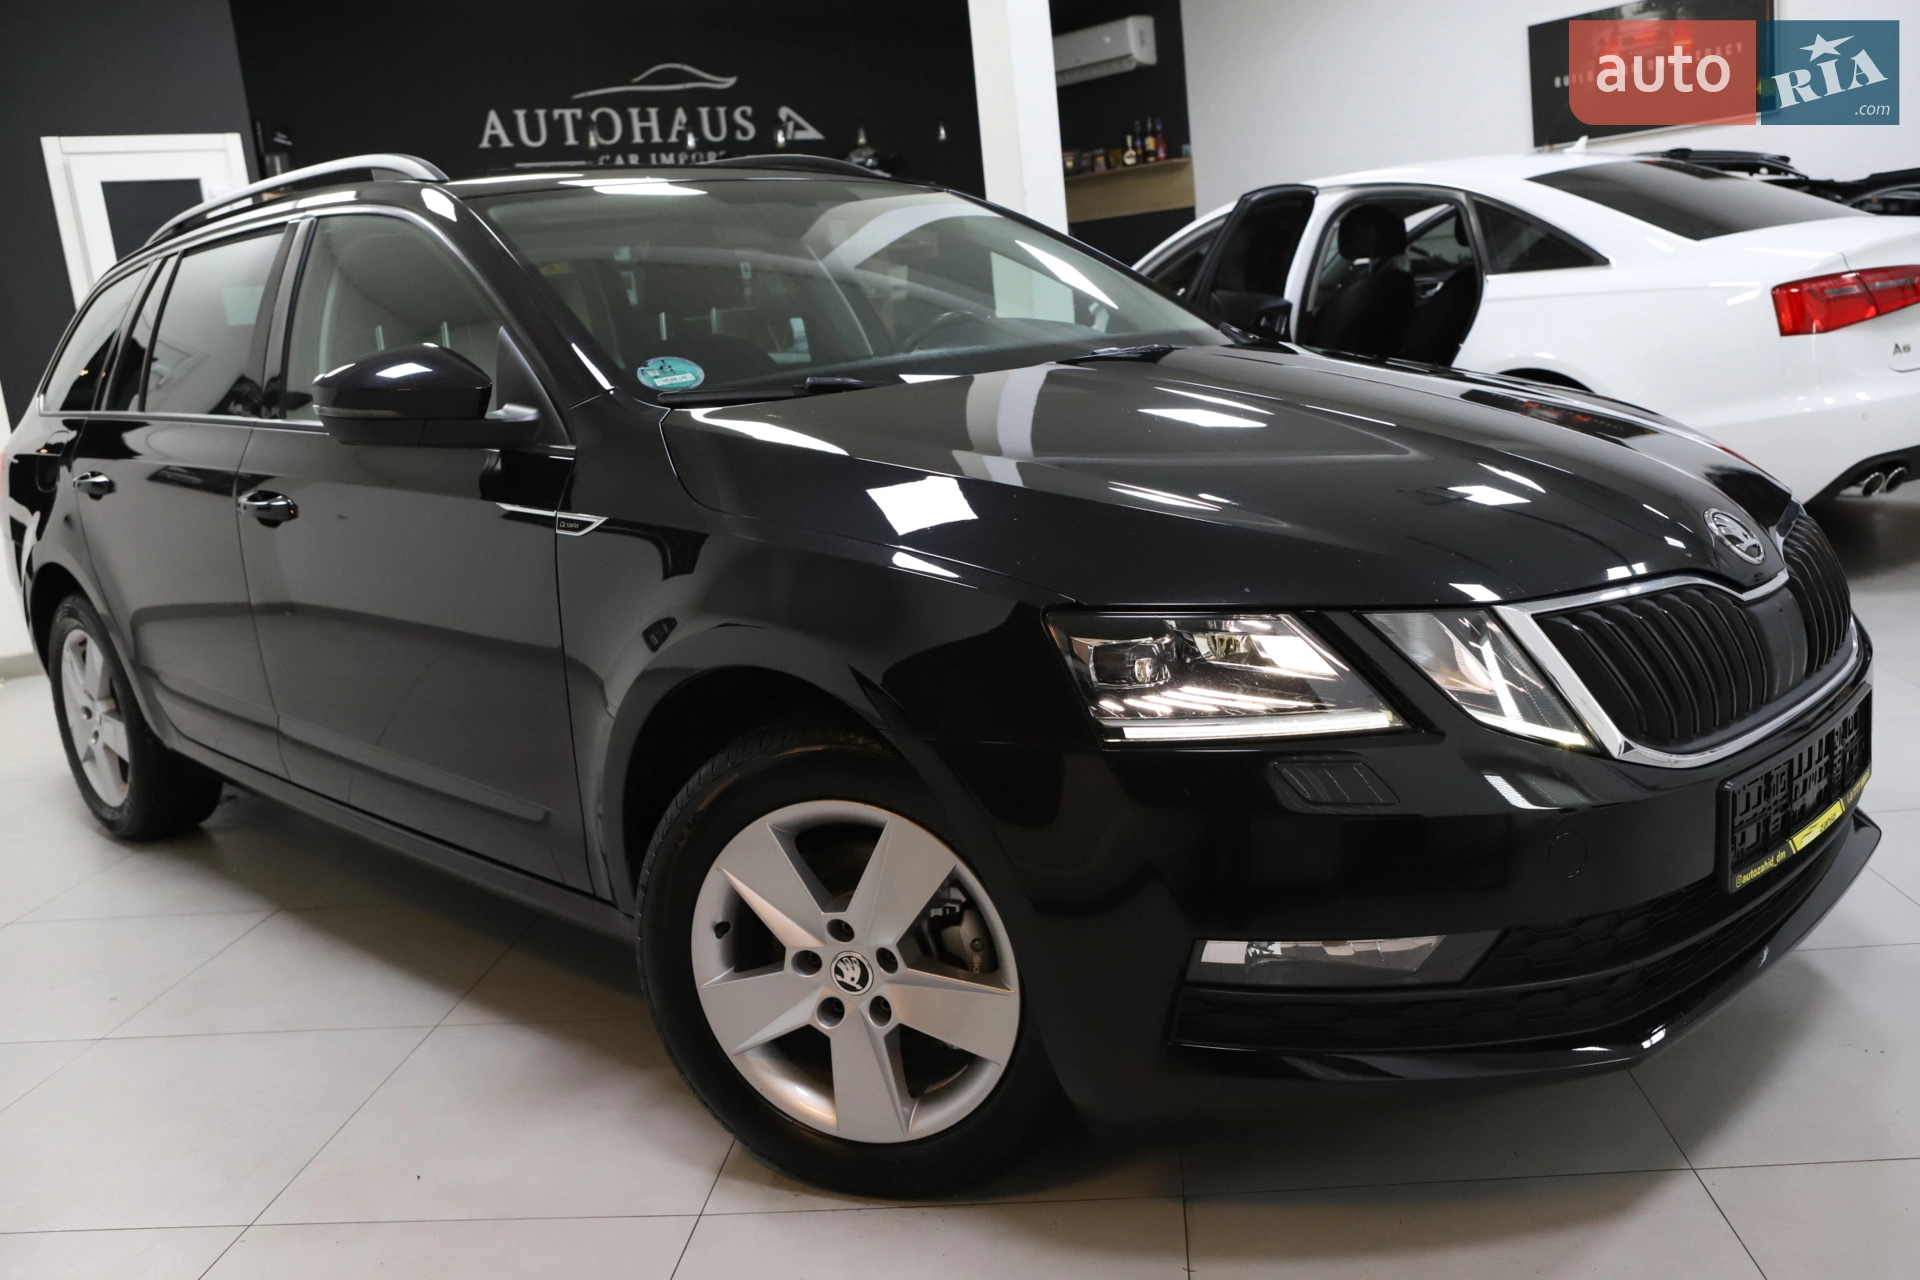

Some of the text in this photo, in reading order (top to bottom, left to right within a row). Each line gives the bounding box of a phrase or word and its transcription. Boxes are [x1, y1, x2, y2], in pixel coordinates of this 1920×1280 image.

[478, 105, 757, 149] AUTOHAUS
[598, 150, 728, 165] CAR IMPOR
[1892, 342, 1912, 356] A6
